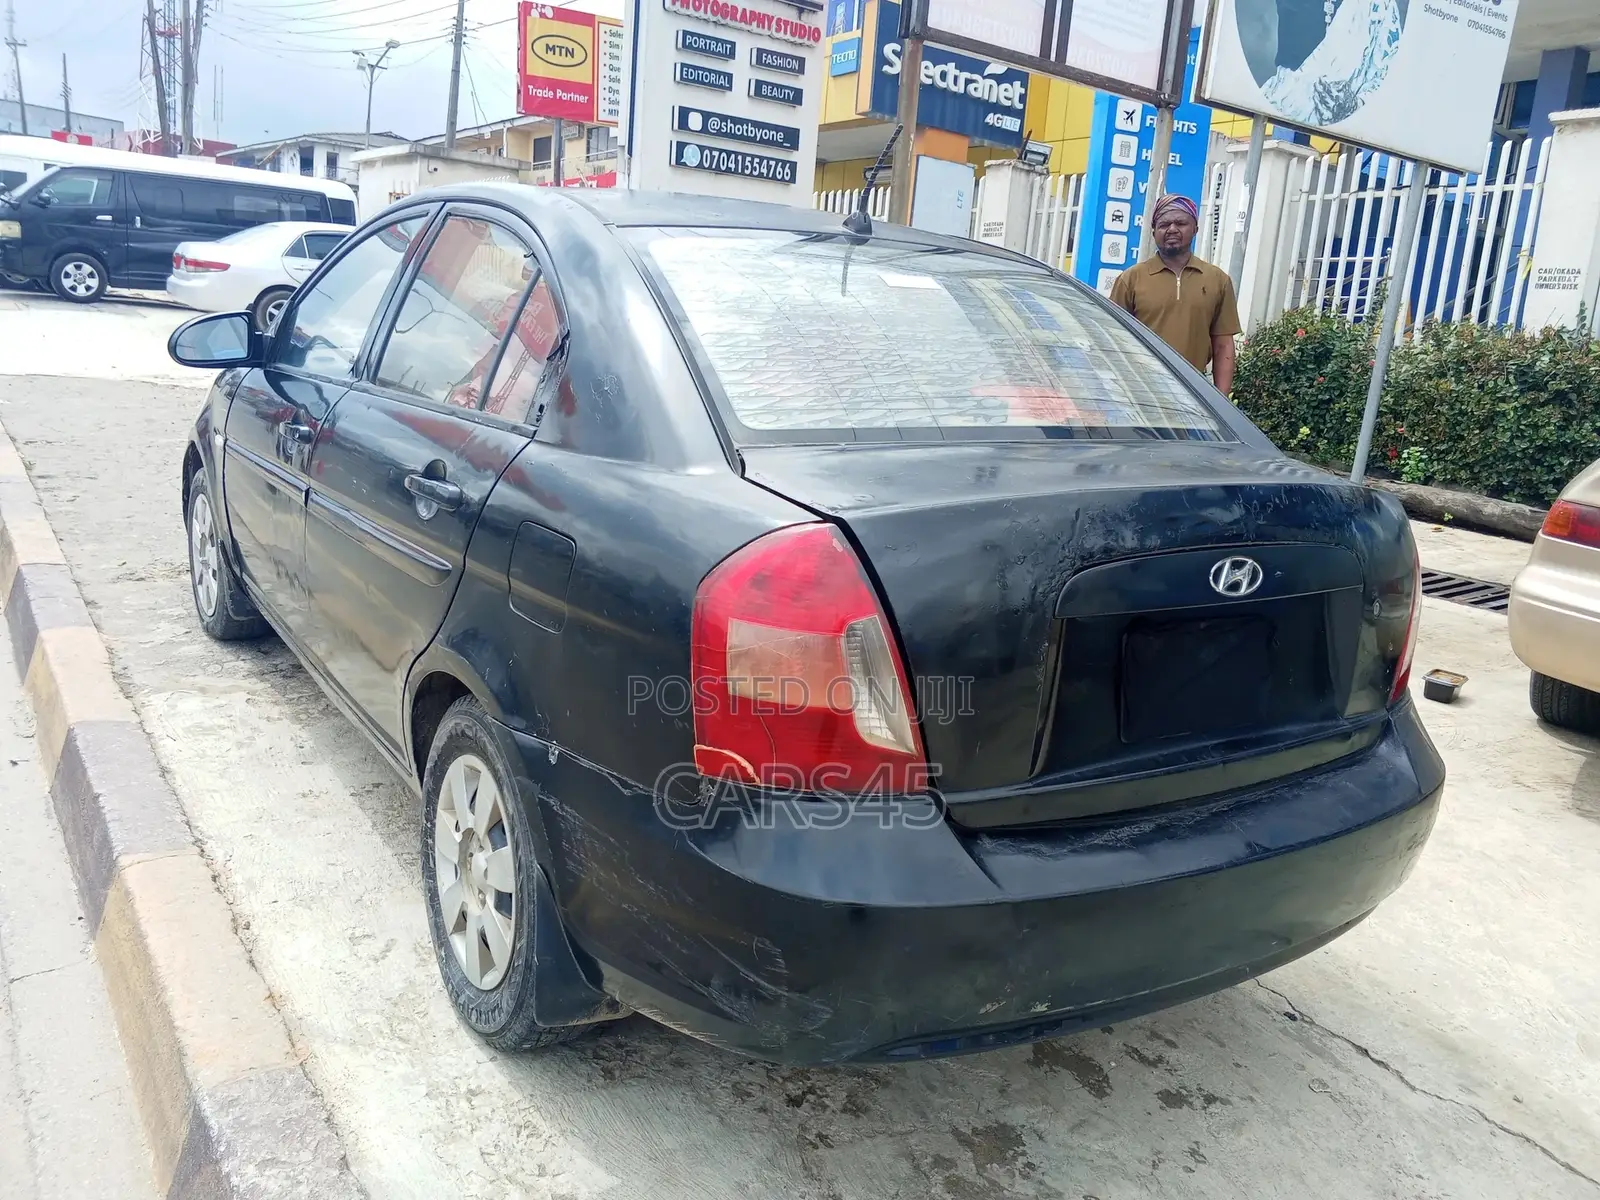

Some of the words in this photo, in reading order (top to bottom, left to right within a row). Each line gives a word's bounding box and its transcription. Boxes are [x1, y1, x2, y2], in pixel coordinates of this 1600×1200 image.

[1423, 4, 1459, 23] Shotbyone
[1487, 8, 1508, 22] Events
[775, 18, 822, 43] STUDIO
[545, 43, 575, 59] MTN
[685, 35, 732, 56] PORTRAIT
[762, 53, 799, 70] FASHION
[832, 49, 857, 65] TECNO
[682, 67, 730, 87] EDITORIAL
[882, 42, 1026, 110] Sectranet
[527, 85, 554, 98] Trade
[556, 89, 590, 103] Partner
[761, 84, 795, 101] BEAUTY
[707, 117, 791, 147] @shotbyone_
[1145, 115, 1198, 134] FHTS
[702, 149, 791, 181] 07041554766
[1141, 148, 1183, 166] HEL
[1537, 267, 1581, 275] CAR/OKADA
